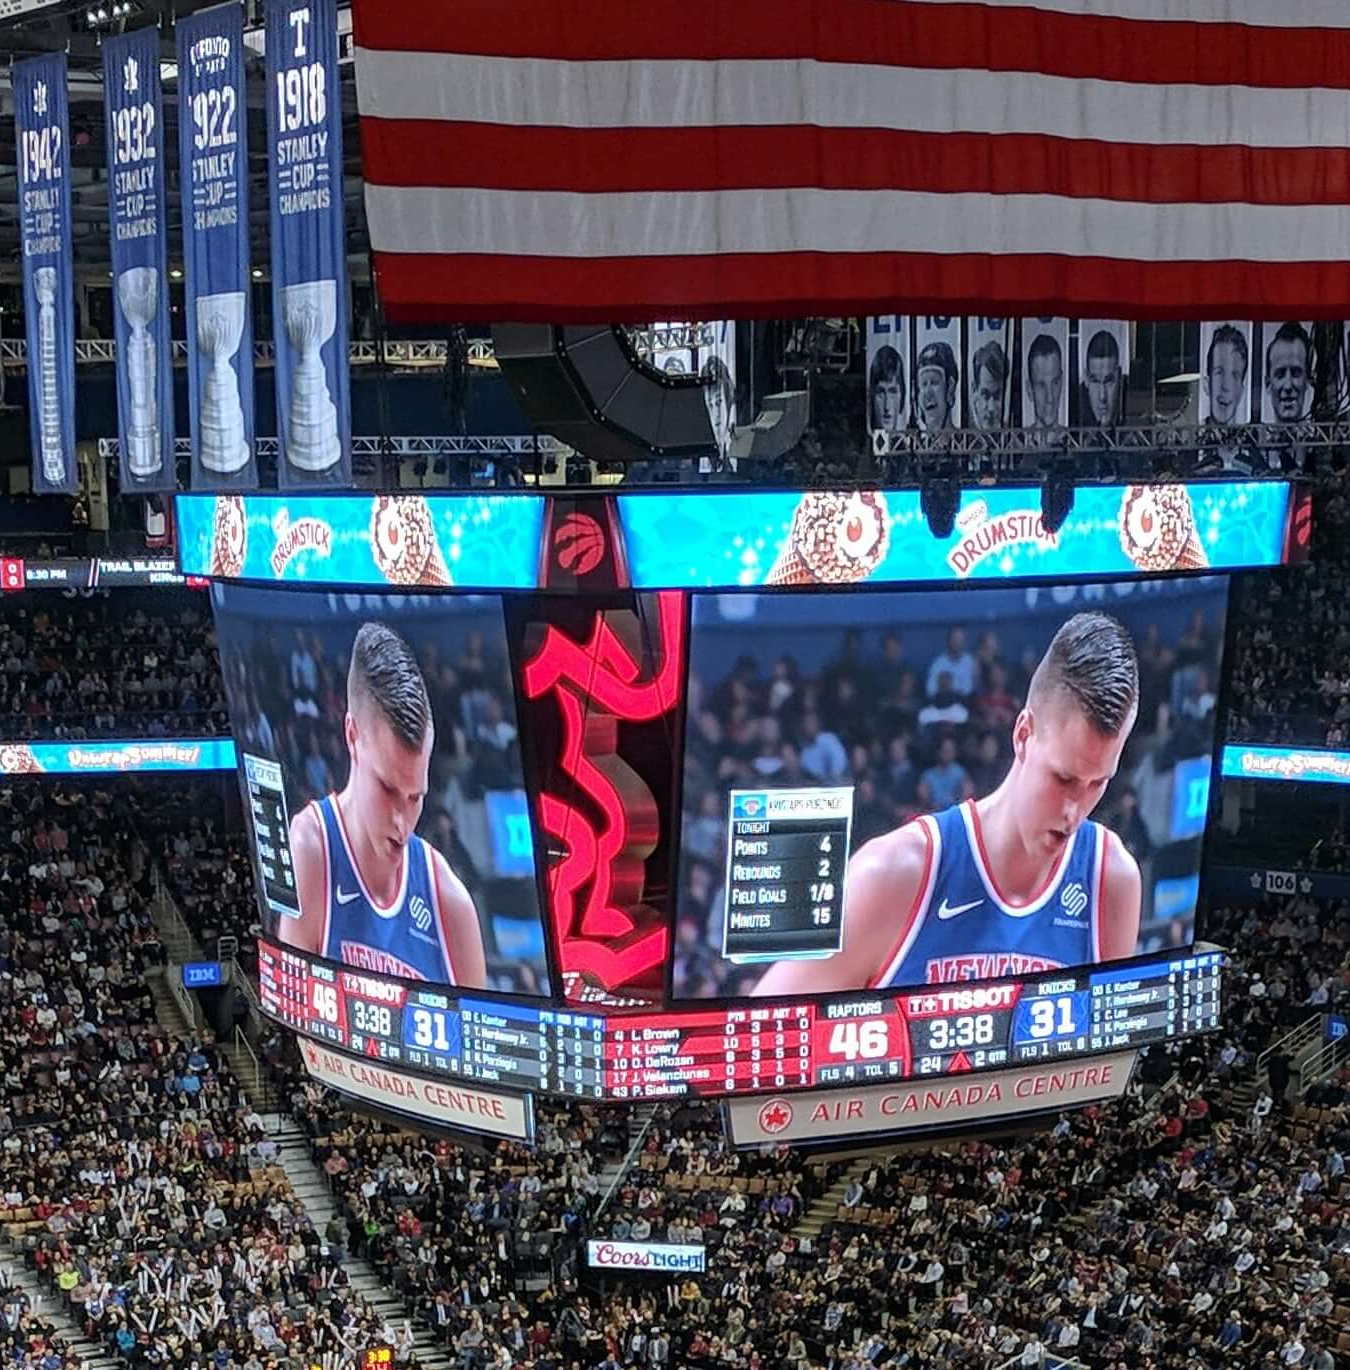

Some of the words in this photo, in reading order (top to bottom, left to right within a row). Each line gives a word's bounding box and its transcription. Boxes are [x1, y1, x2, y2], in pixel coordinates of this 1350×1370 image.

[290, 8, 309, 57] T
[277, 62, 326, 132] 1918
[188, 86, 237, 150] 922
[112, 102, 156, 165] 1932
[22, 127, 62, 184] 1942
[277, 131, 328, 166] STANLEY
[114, 165, 155, 195] STANLEY
[292, 164, 315, 189] CUP
[126, 195, 145, 217] CUP
[279, 187, 331, 216] CHAMPIONS
[116, 217, 157, 240] CHAMPIONS
[273, 521, 330, 572] DRUMSTICK
[101, 561, 132, 573] TRAIL
[736, 822, 770, 834] TONIGHT
[820, 836, 831, 853] 4
[818, 859, 830, 877] 2
[810, 884, 835, 903] 1/8
[1267, 873, 1295, 892] 106
[812, 906, 831, 925] 15
[188, 968, 214, 982] IBM
[358, 974, 405, 1003] TISSOT
[939, 984, 1015, 1013] TISSOT
[1039, 979, 1076, 995] KNICKS
[312, 983, 339, 1023] 46
[828, 1001, 882, 1018] RAPTORS
[354, 1001, 392, 1036] 3:38
[481, 1012, 508, 1028] Kanter
[727, 1011, 746, 1023] PTS
[1030, 997, 1076, 1038] 31
[413, 1009, 450, 1050] 31
[643, 1028, 680, 1041] Brown
[828, 1020, 889, 1061] 46
[929, 1014, 994, 1050] 3:38
[351, 1034, 364, 1052] 24
[645, 1042, 680, 1056] Lowry
[613, 1059, 628, 1071] 10
[645, 1055, 694, 1069] DeRozan
[821, 1069, 839, 1081] FLS
[865, 1065, 884, 1076] TOL
[888, 1062, 898, 1075] 5
[920, 1056, 941, 1074] 24
[975, 1050, 985, 1066] 2
[323, 1053, 346, 1081] AIR
[351, 1062, 417, 1101] CANADA
[423, 1084, 507, 1121] CENTRE
[613, 1072, 628, 1084] 17
[642, 1068, 710, 1083] Valanciunas
[644, 1083, 687, 1096] Siakam
[811, 1098, 863, 1123] AIR
[879, 1082, 1002, 1115] CANADA
[1014, 1064, 1114, 1098] CENTRE
[596, 1244, 650, 1266] Coors
[650, 1252, 703, 1270] LIGHT
[368, 1349, 390, 1364] 3:38
